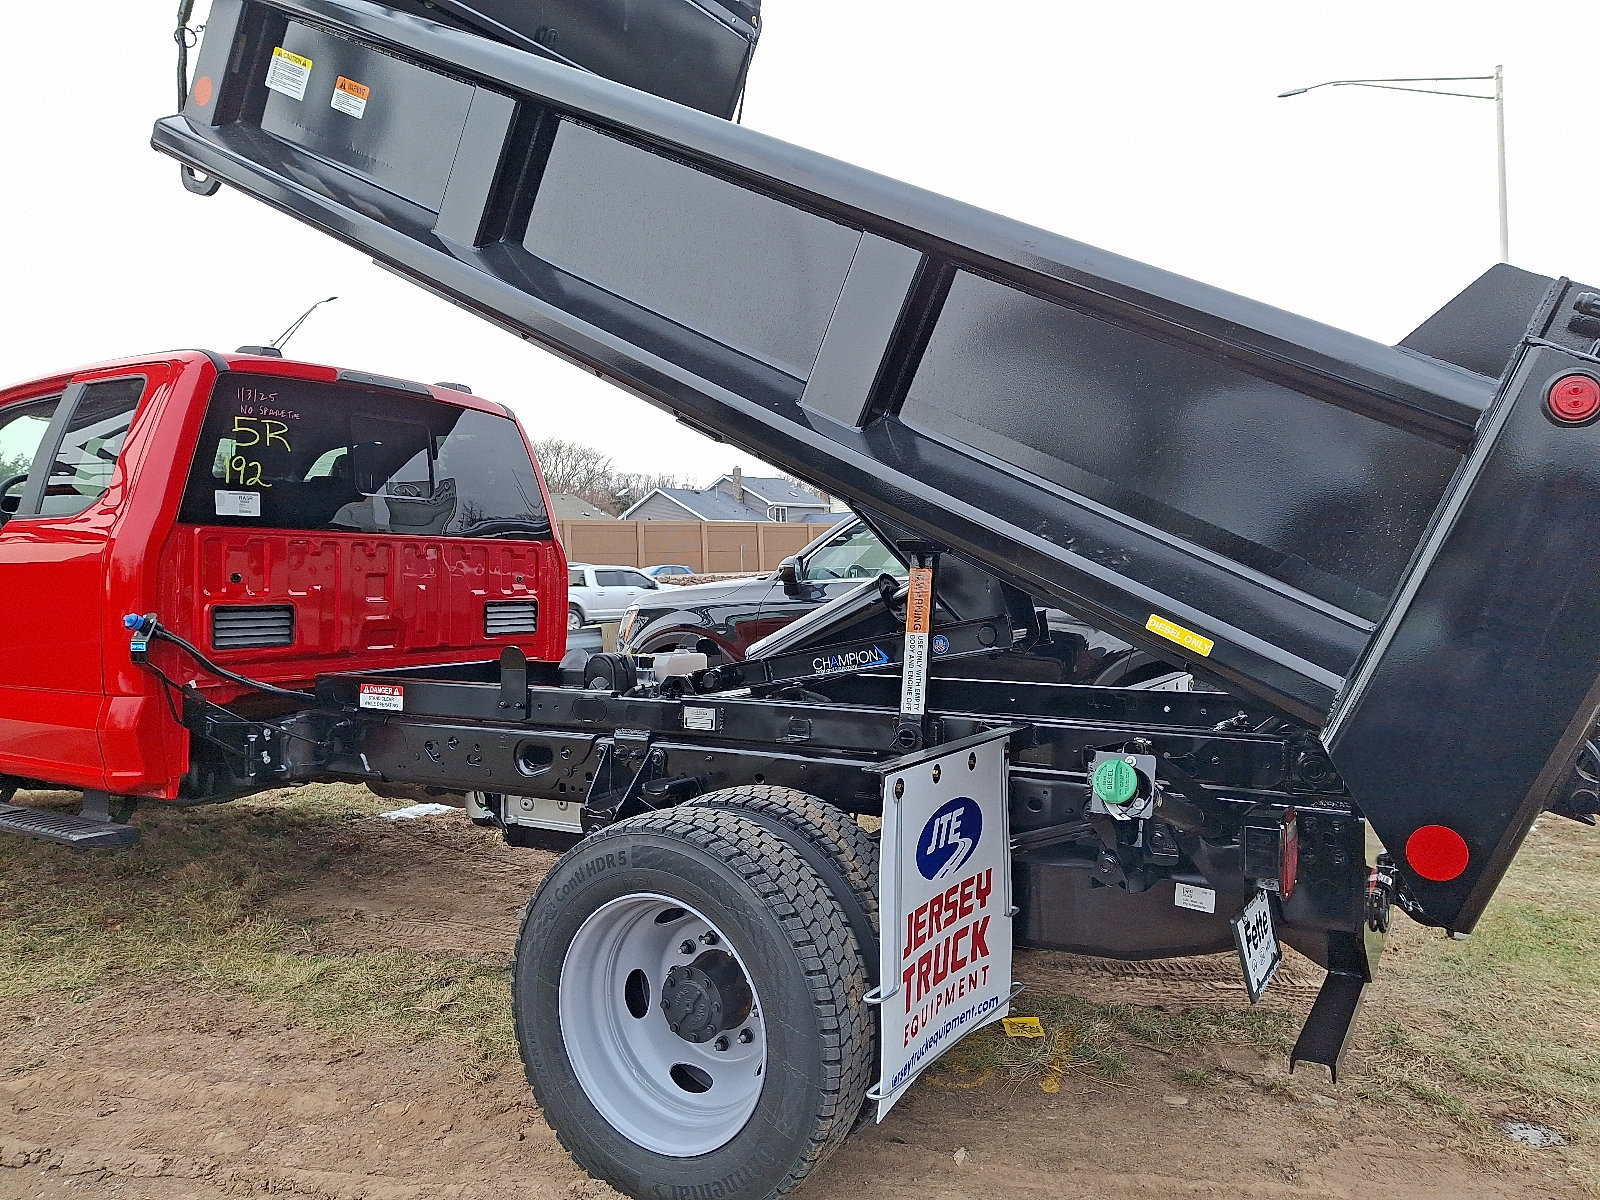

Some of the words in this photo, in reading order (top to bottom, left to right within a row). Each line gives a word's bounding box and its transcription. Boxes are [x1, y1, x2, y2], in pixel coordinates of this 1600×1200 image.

[283, 52, 303, 65] CAUTION
[347, 83, 366, 96] WARNING
[237, 387, 278, 402] 1/3/25
[240, 405, 253, 414] NO
[232, 416, 291, 452] 5R
[224, 456, 272, 487] 192
[908, 634, 916, 655] BODY
[1148, 618, 1181, 640] DIESEL
[1184, 635, 1211, 652] ONLY
[812, 648, 879, 670] CHAMPION
[370, 686, 393, 695] DANGER
[906, 671, 914, 697] ENGINE
[914, 669, 922, 686] WITH
[913, 688, 921, 711] EMPTY
[926, 806, 965, 856] JTE
[554, 866, 587, 903] Conti
[585, 853, 617, 877] HDR
[617, 850, 627, 866] 5
[902, 867, 993, 961] JERSEY
[1243, 909, 1269, 960] Fette
[902, 914, 991, 1015] TRUCK
[903, 964, 990, 1049] EQUIPMENT
